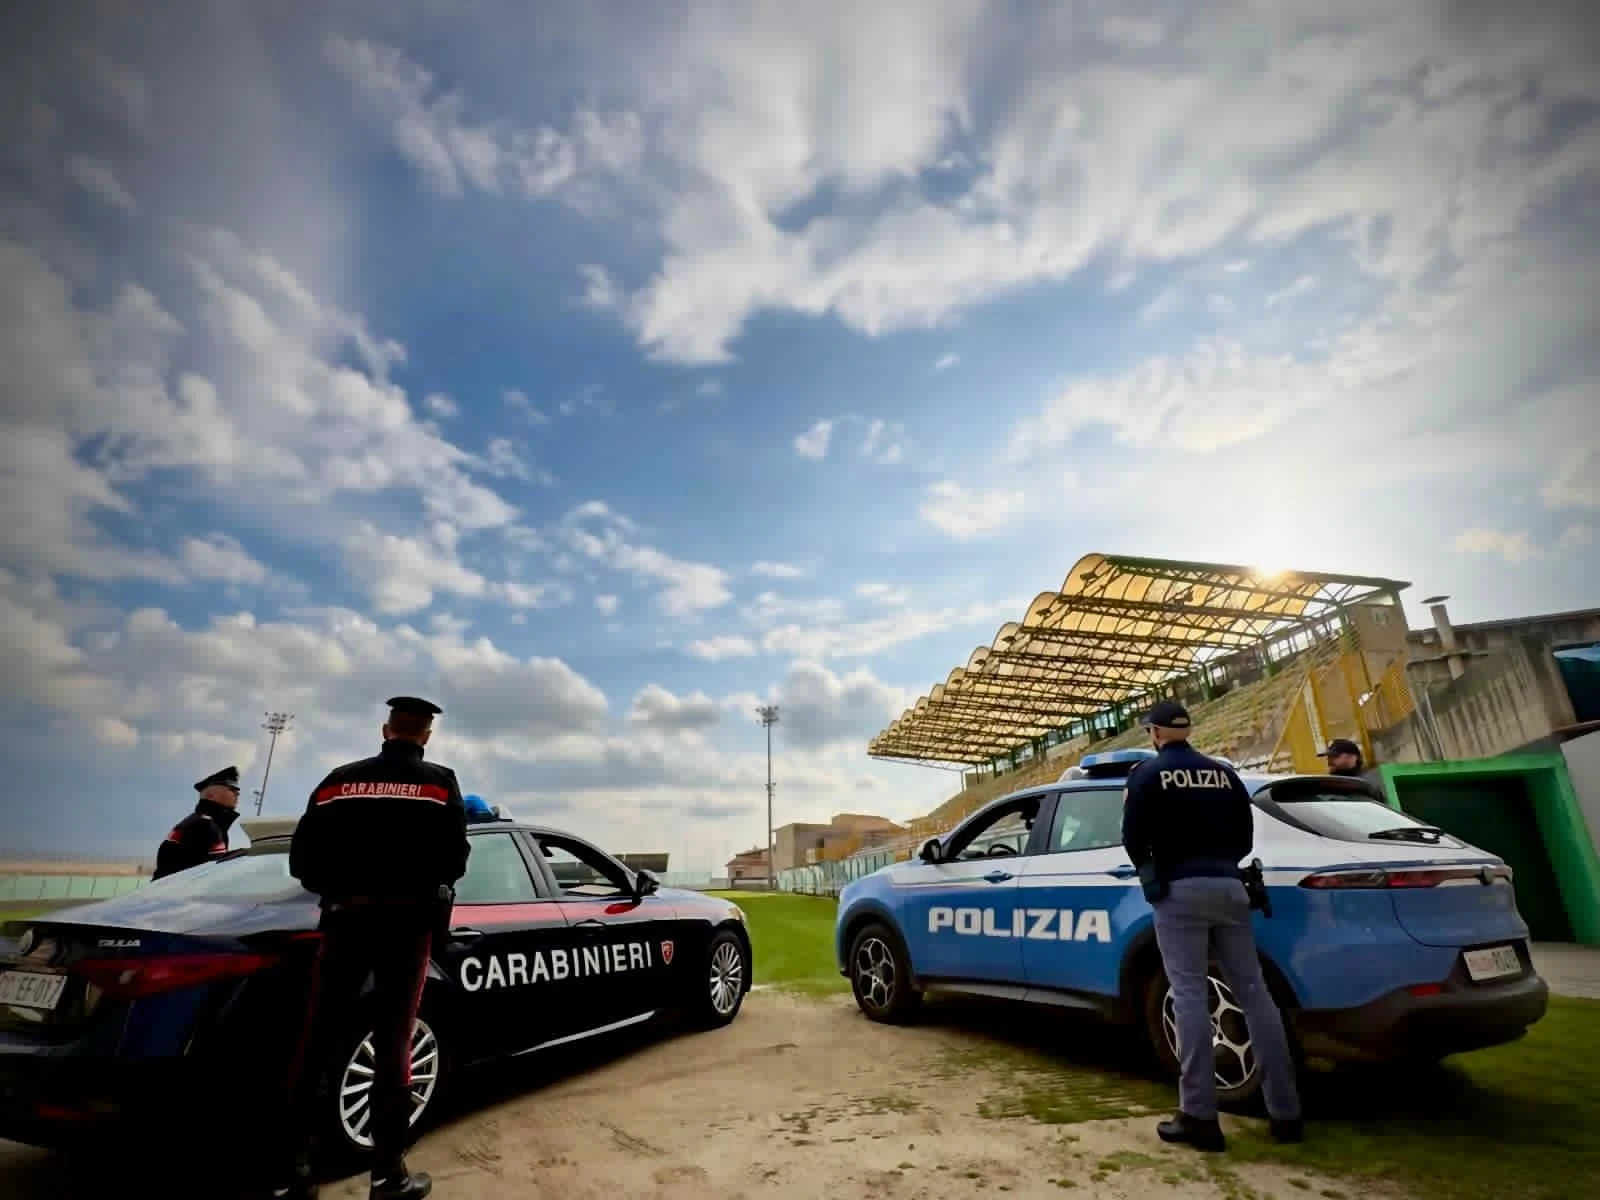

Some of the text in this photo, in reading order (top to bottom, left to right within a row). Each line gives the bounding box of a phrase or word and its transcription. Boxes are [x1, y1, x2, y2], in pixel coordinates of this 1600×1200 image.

[341, 782, 422, 796] CARABINIERI
[1160, 769, 1232, 790] POLIZIA
[928, 907, 1112, 942] POLIZIA
[460, 941, 652, 992] CARABINIERI
